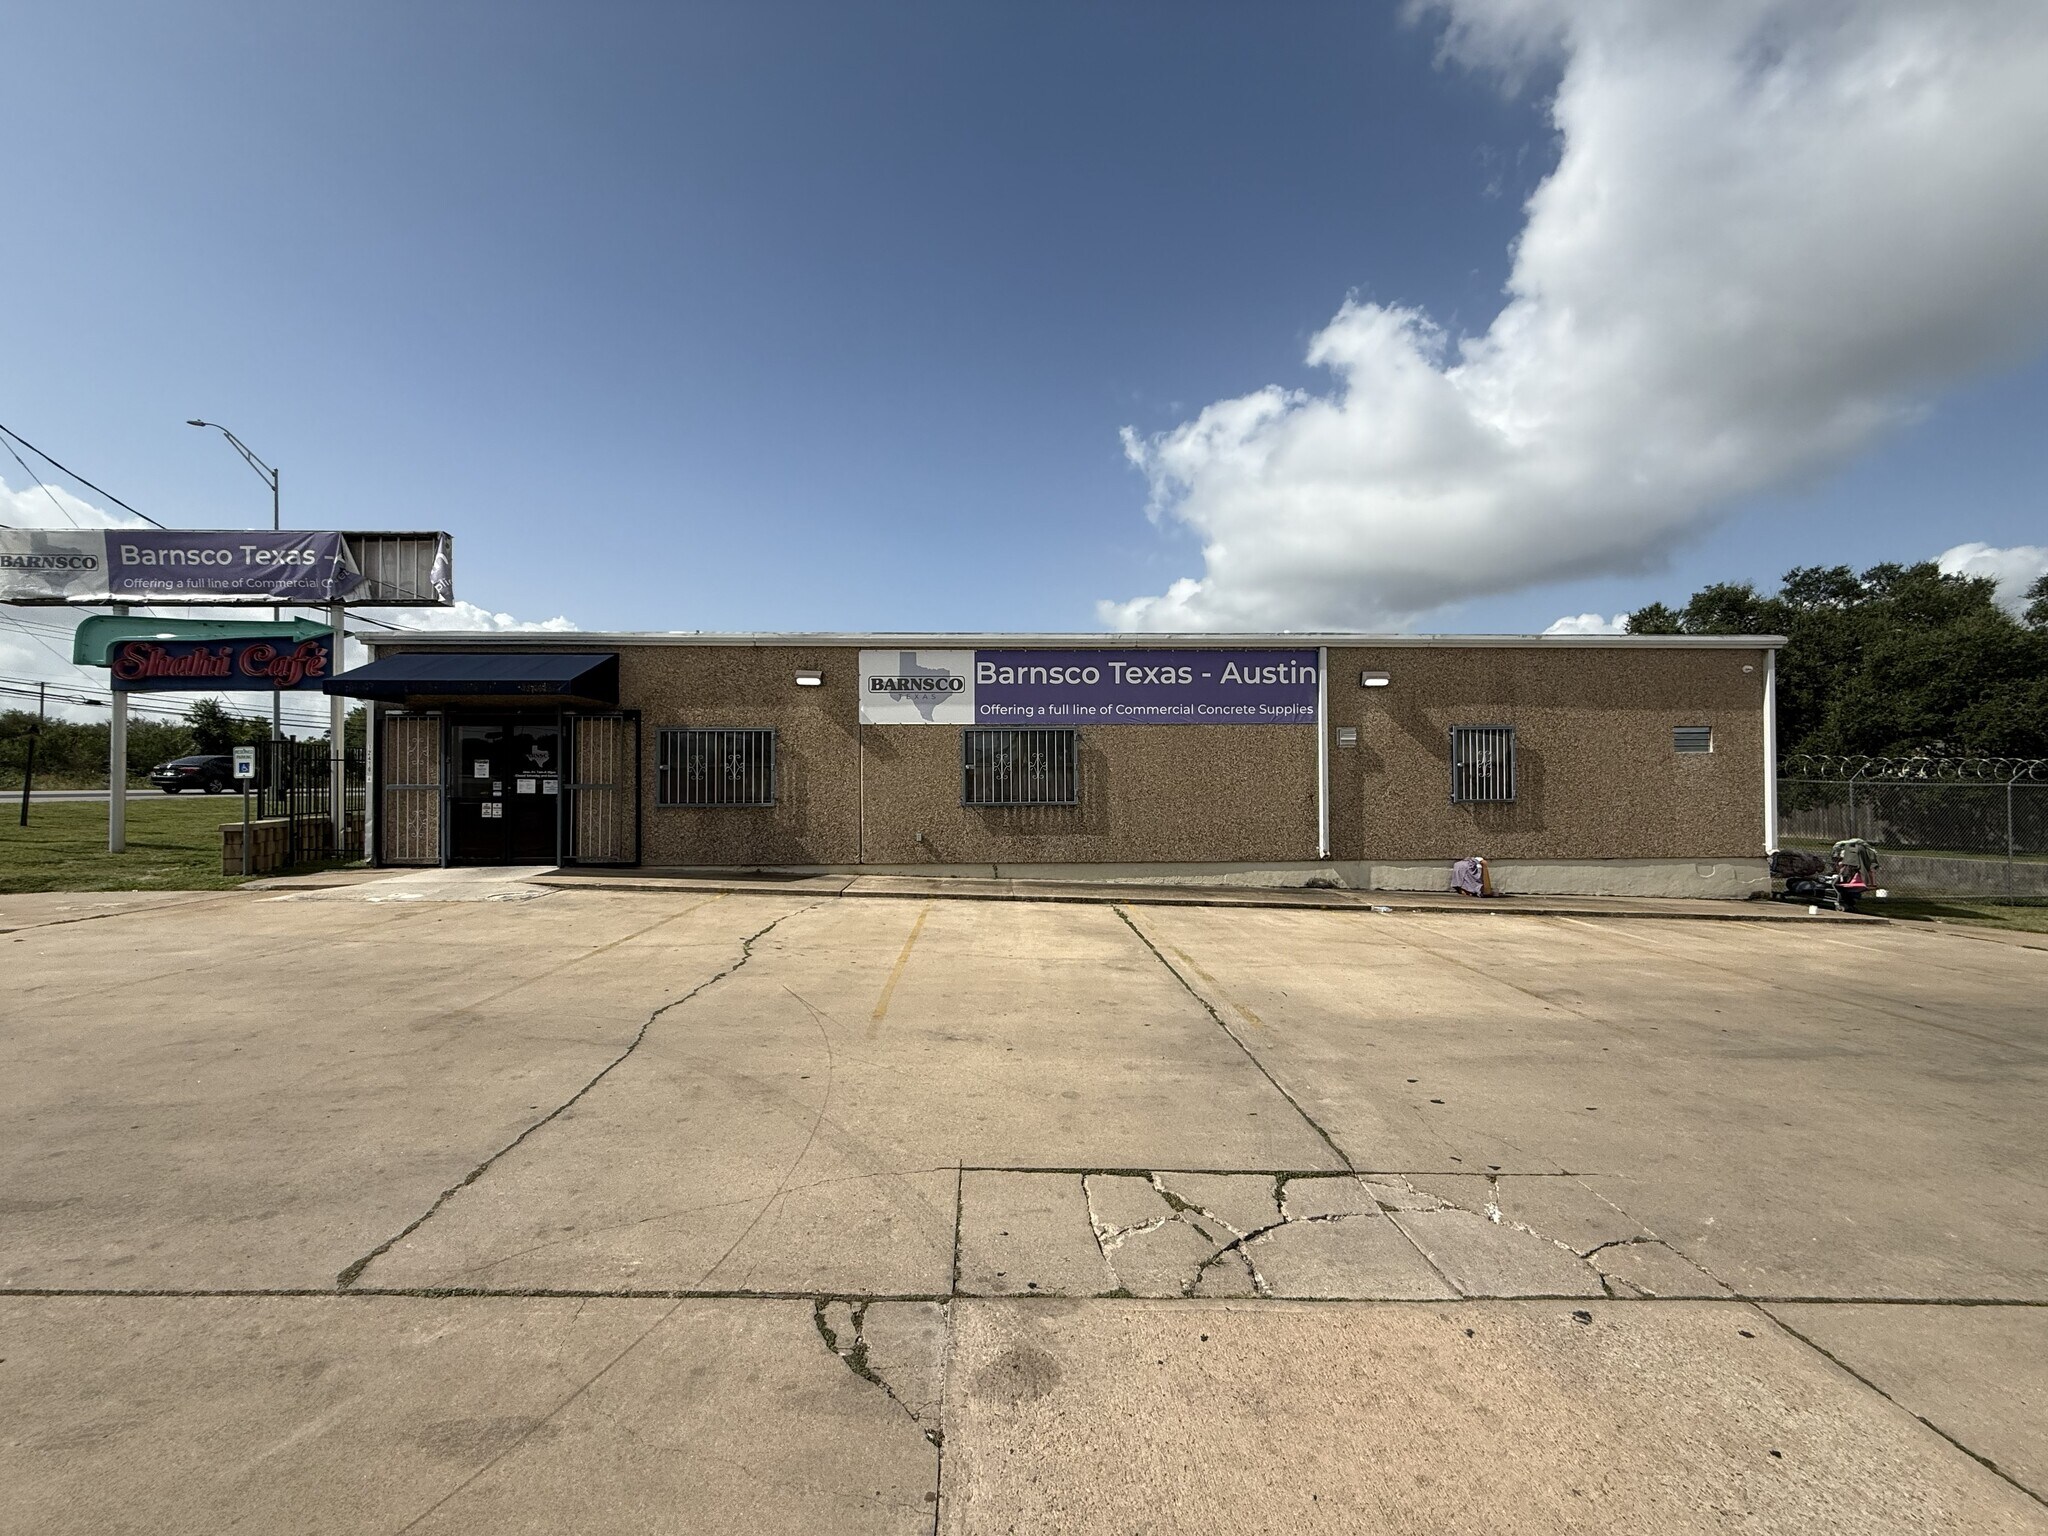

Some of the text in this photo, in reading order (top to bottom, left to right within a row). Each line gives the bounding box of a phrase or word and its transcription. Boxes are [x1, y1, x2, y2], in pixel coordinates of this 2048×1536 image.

[0, 555, 97, 569] BARNSCO
[120, 544, 233, 566] Barnsco
[239, 545, 316, 566] Texas
[123, 578, 174, 590] Offering
[176, 579, 184, 588] a
[185, 577, 205, 588] full
[207, 578, 229, 588] line
[229, 577, 245, 588] of
[246, 577, 319, 589] Commercial
[111, 640, 328, 687] Shahi Café
[976, 661, 1100, 685] Barnsco
[1107, 661, 1193, 685] Texas
[1219, 659, 1317, 685] Austin
[870, 677, 964, 692] BARNSCO
[980, 703, 1314, 717] Offering a full line of Commercial Concrete Supplies
